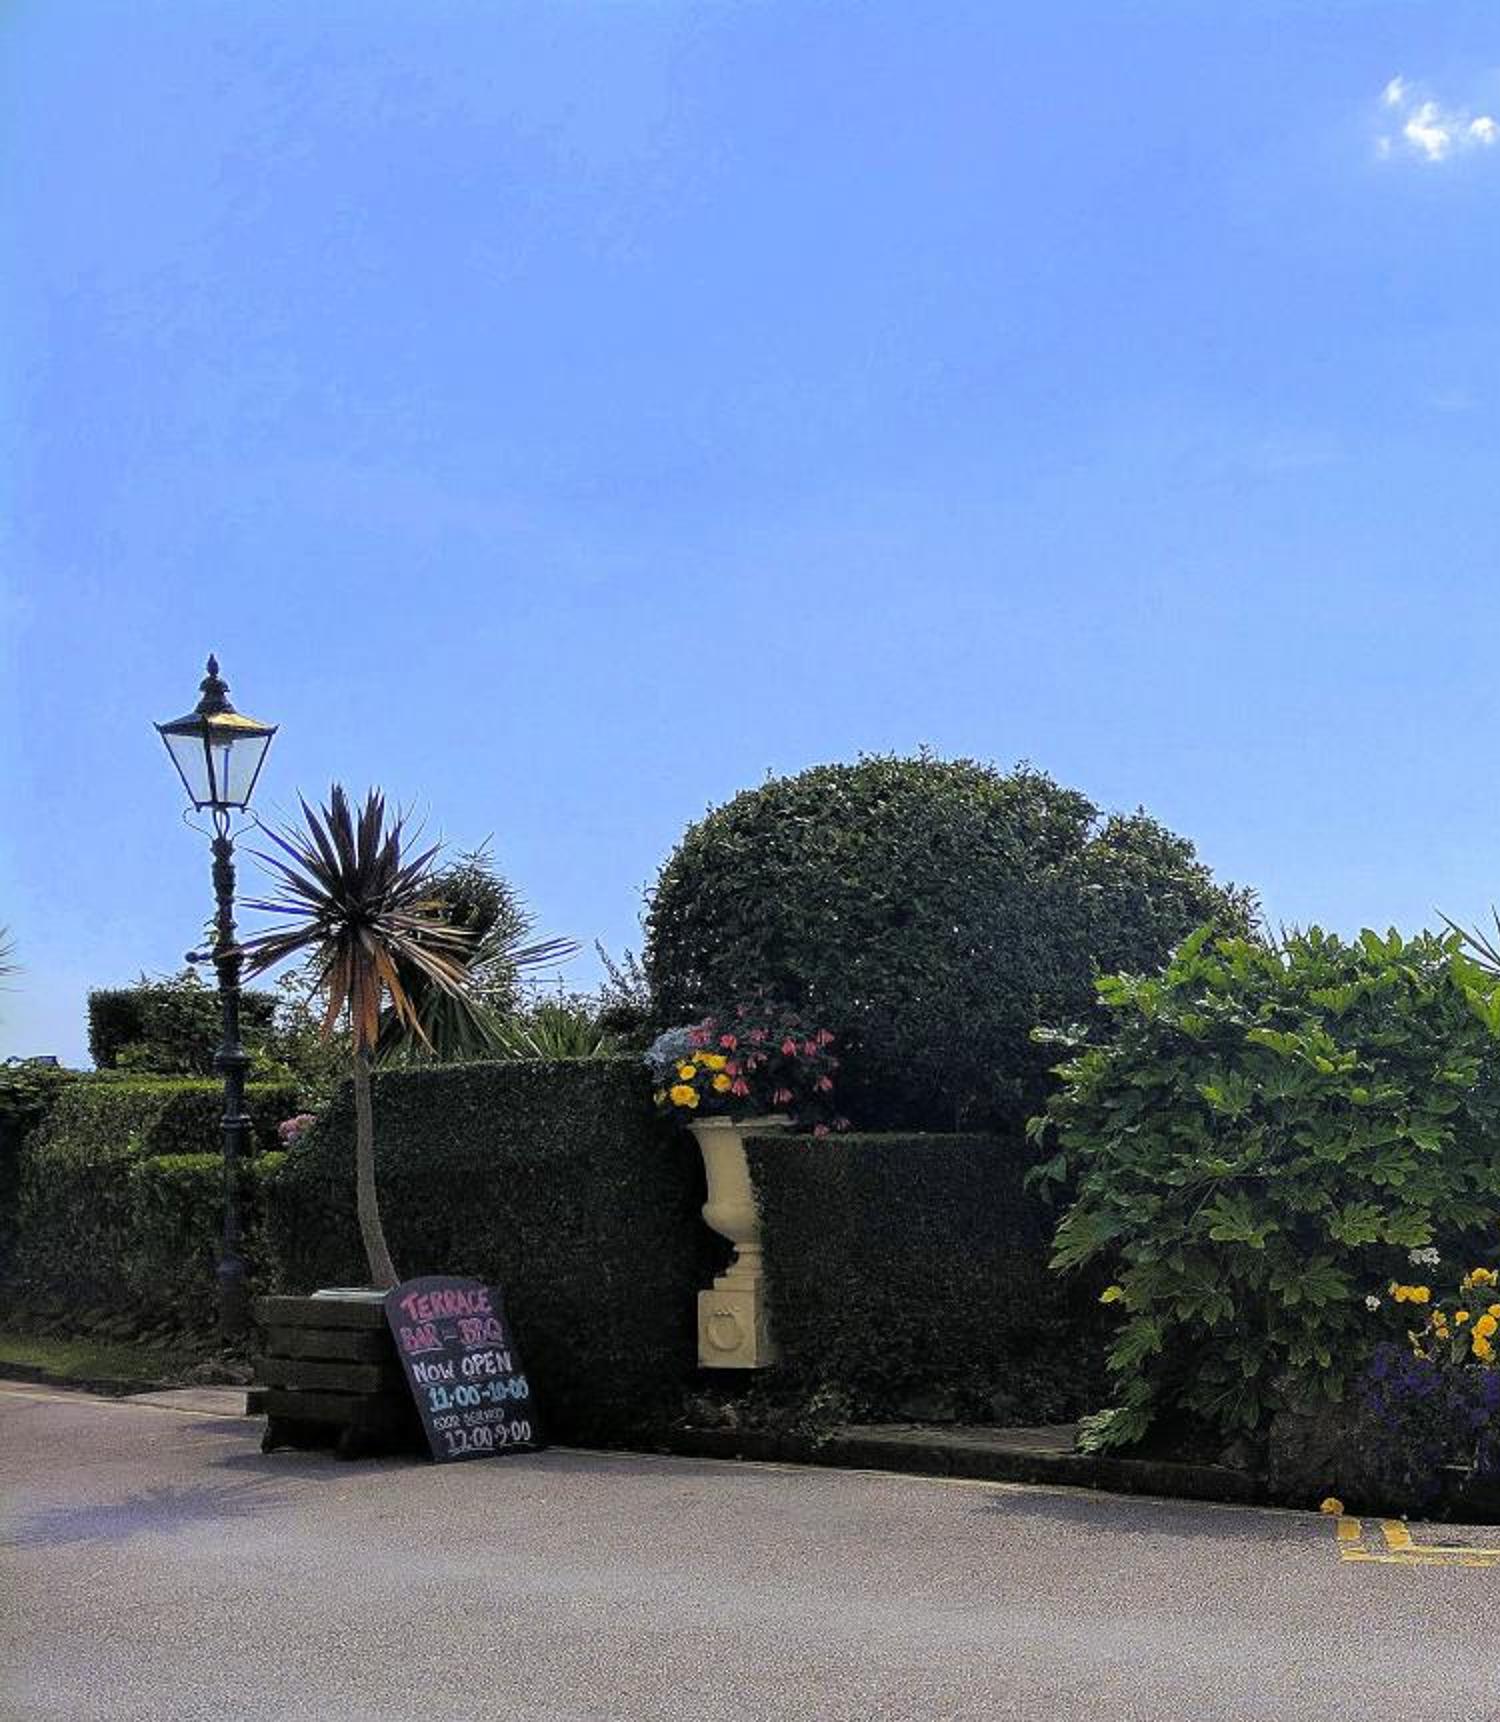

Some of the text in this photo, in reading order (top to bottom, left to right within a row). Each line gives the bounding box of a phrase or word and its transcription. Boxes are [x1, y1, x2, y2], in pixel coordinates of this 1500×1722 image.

[400, 1287, 493, 1321] TERRACE
[400, 1323, 443, 1350] BAR
[457, 1317, 504, 1346] BBQ
[412, 1351, 513, 1383] NOW OPEN
